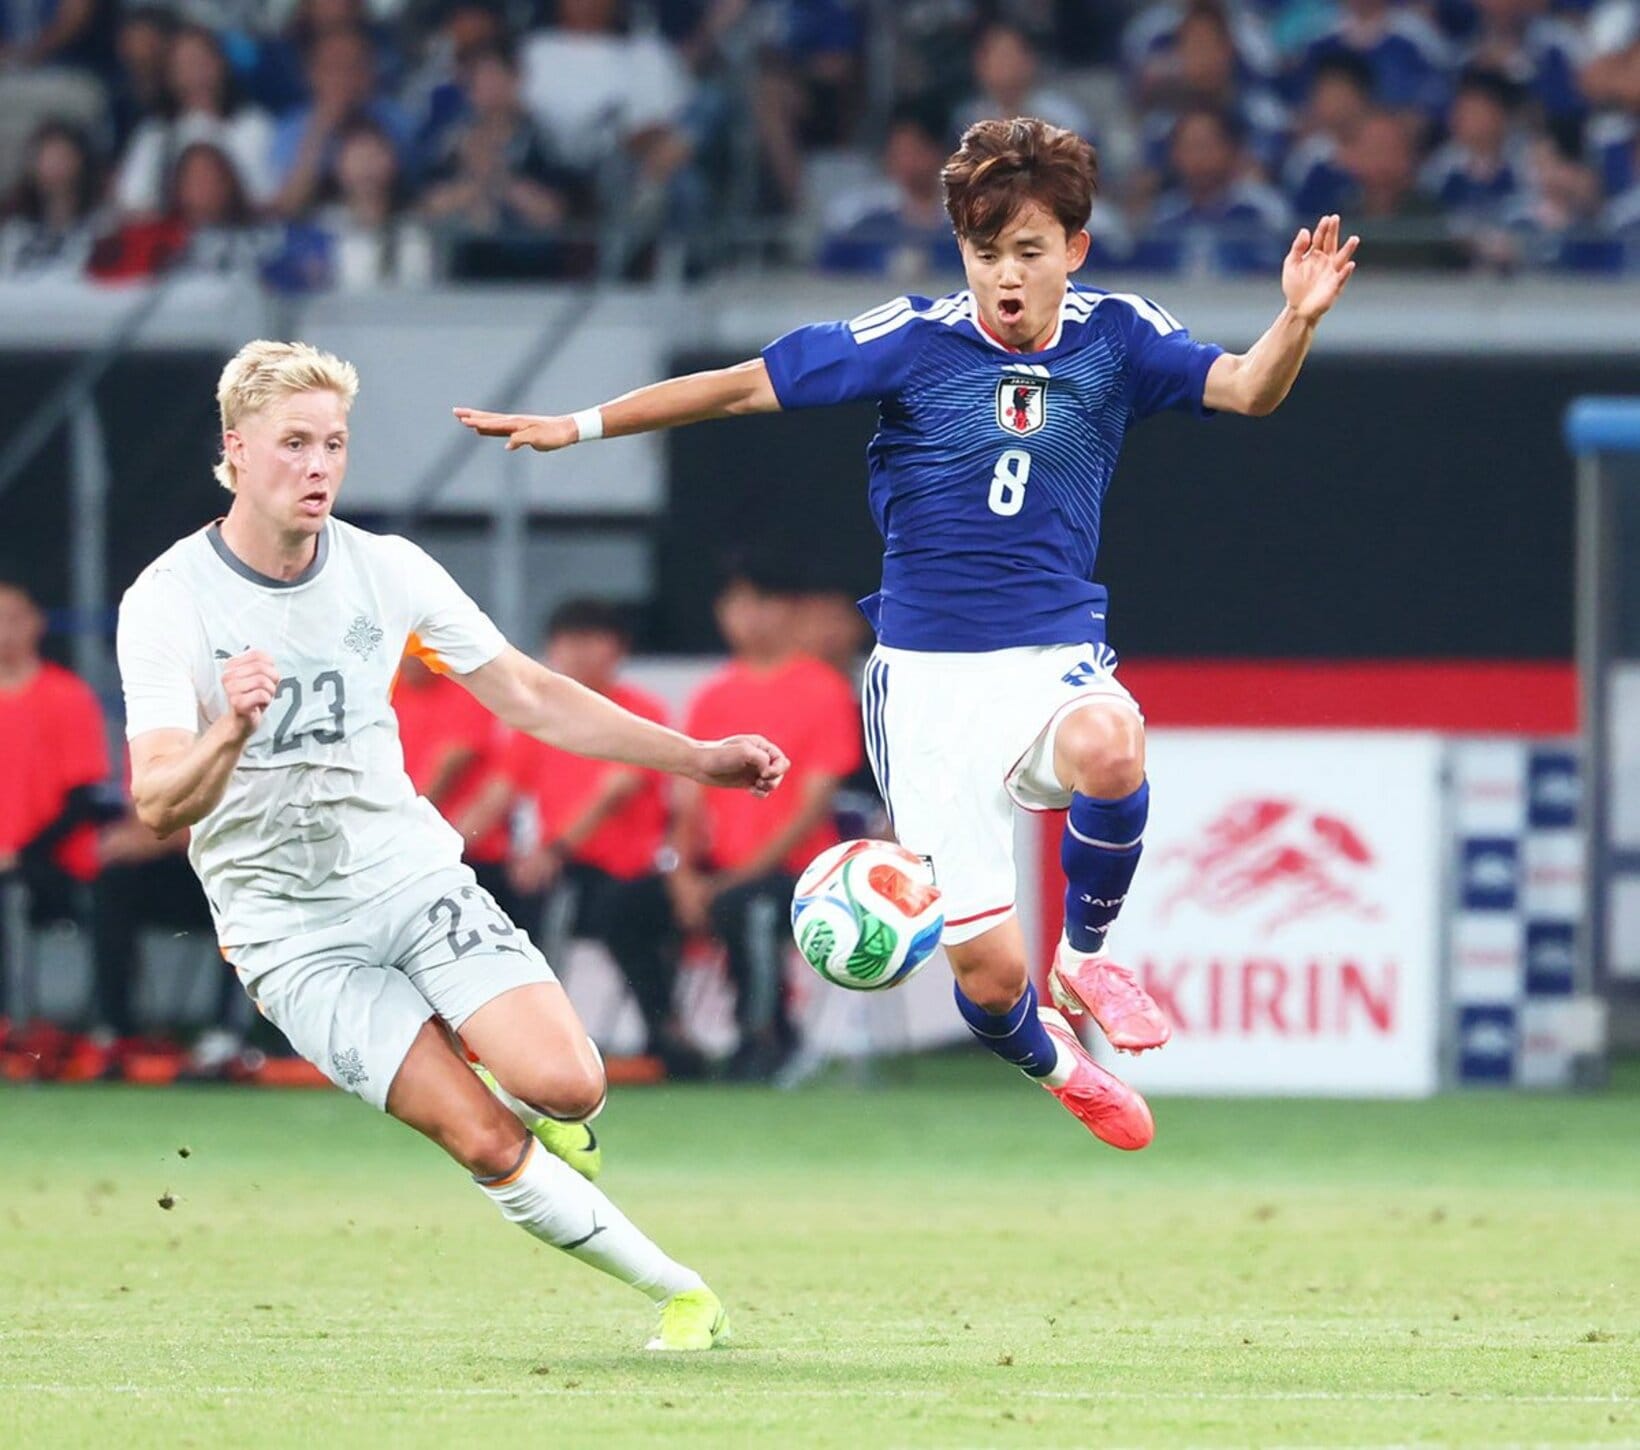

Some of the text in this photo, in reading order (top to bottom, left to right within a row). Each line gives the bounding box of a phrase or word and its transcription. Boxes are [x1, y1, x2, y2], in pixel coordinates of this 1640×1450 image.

[988, 450, 1031, 516] 8
[272, 669, 346, 754] 23
[1143, 957, 1397, 1034] KIRIN
